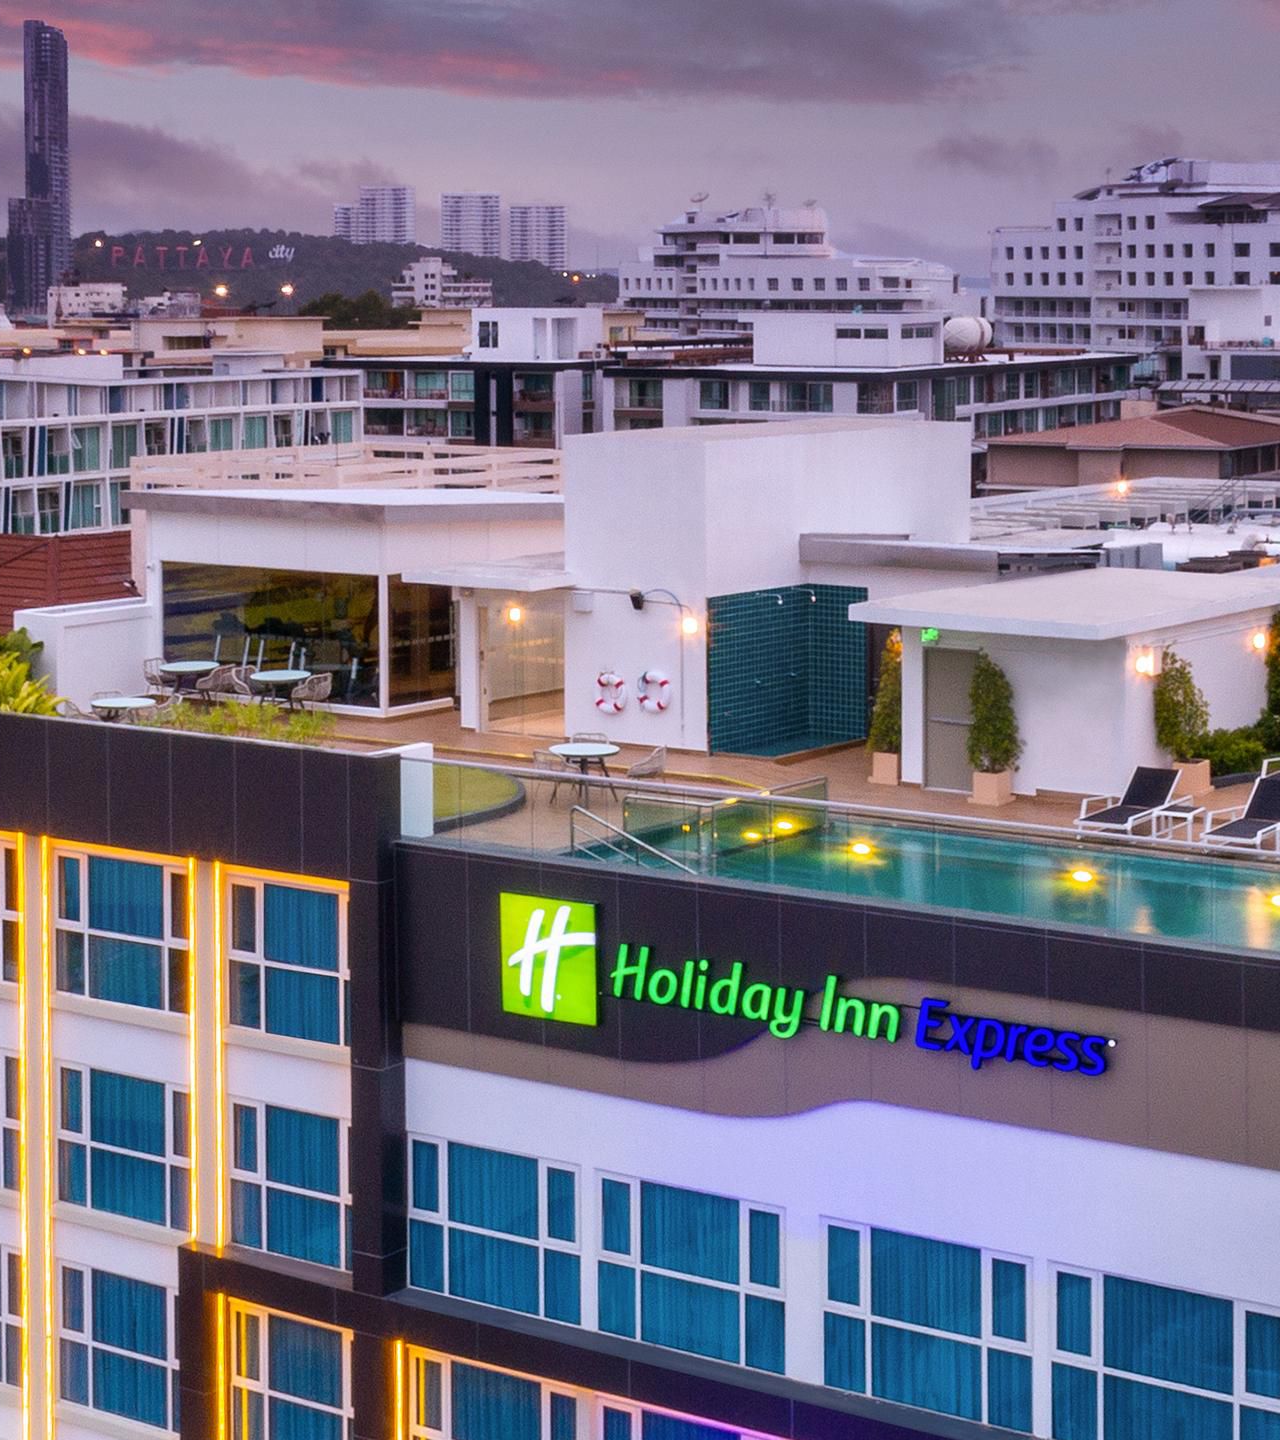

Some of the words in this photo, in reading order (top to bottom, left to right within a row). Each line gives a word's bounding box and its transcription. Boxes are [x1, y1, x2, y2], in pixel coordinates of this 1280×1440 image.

[110, 244, 255, 269] PATTAYA
[267, 243, 295, 262] city
[609, 943, 805, 1039] Holiday
[819, 974, 900, 1043] Inn
[914, 996, 1107, 1076] Express
